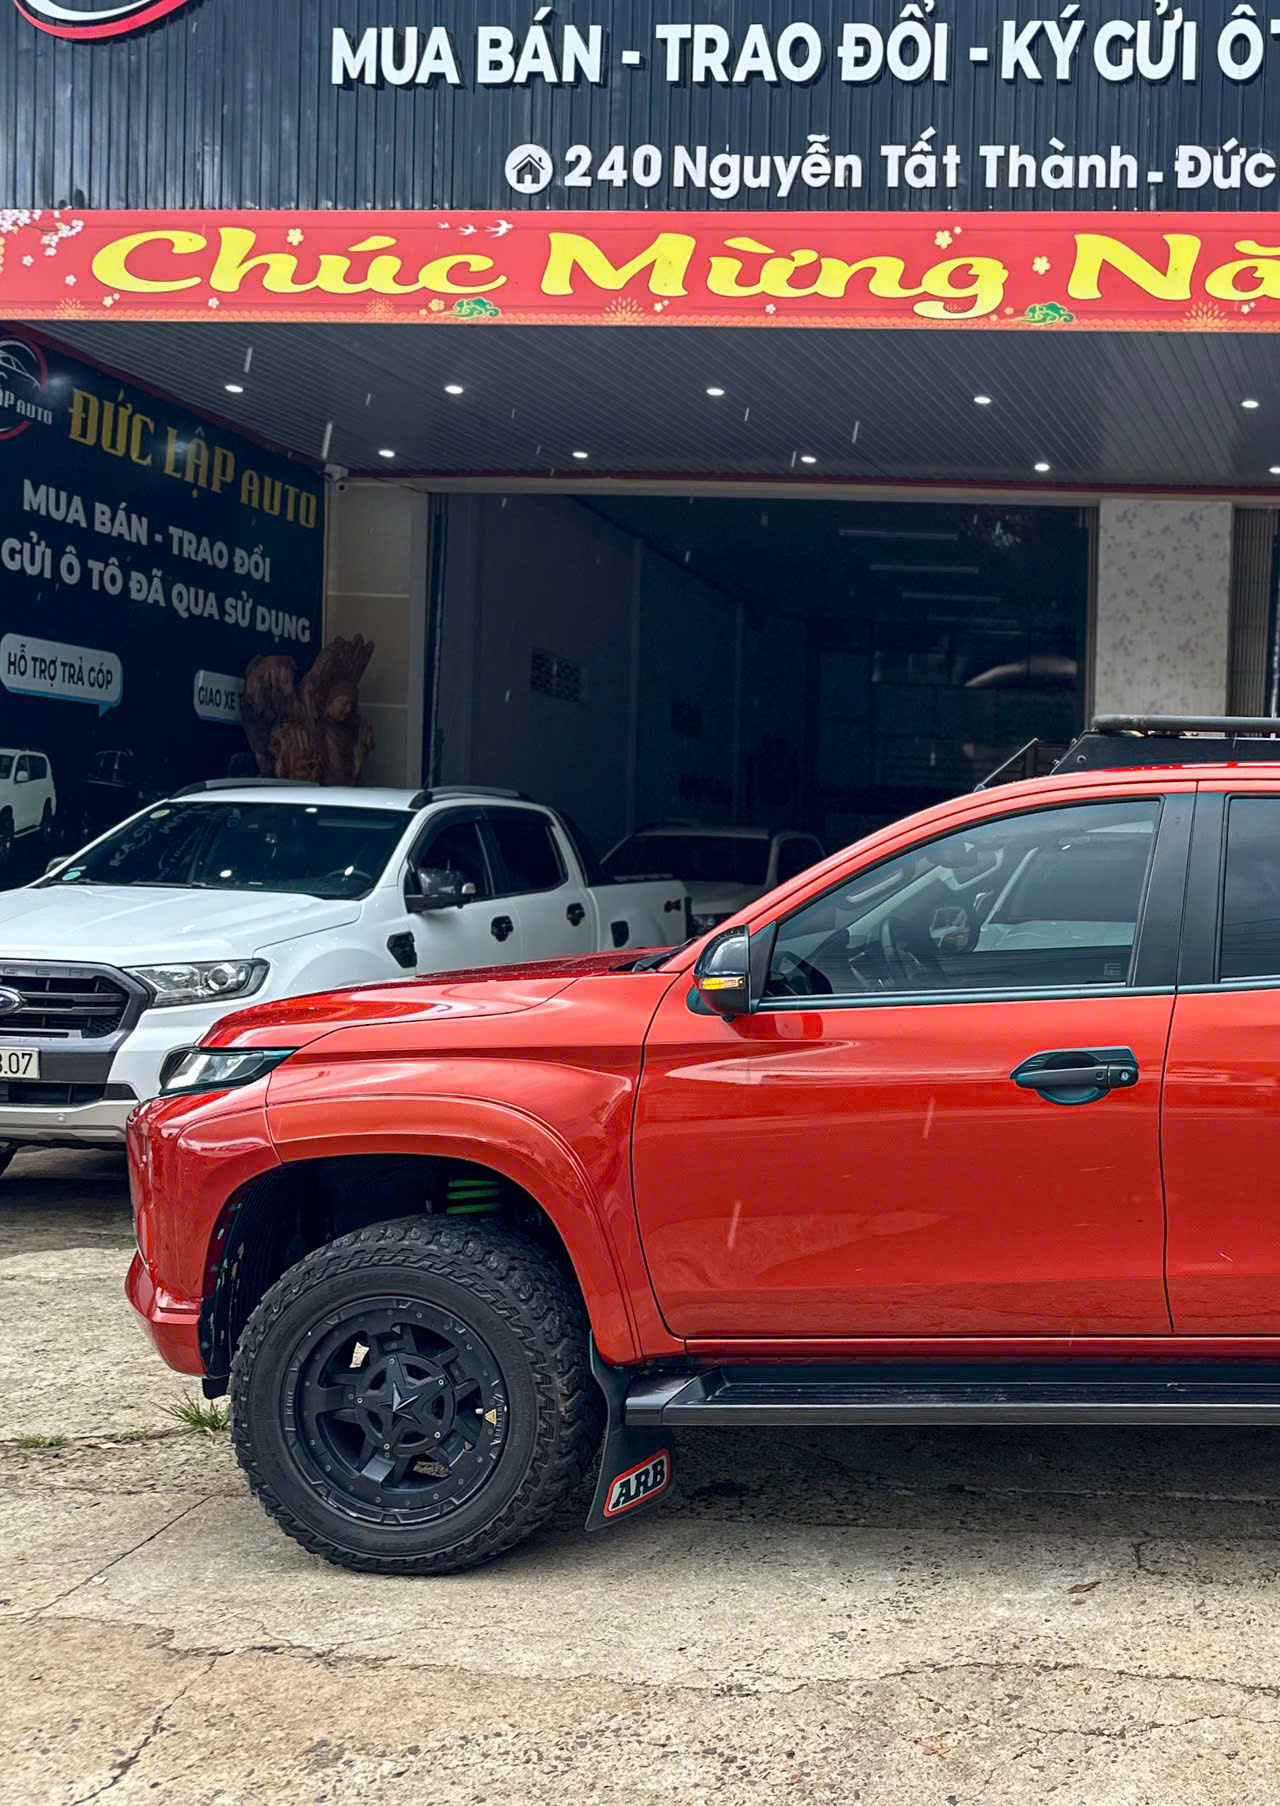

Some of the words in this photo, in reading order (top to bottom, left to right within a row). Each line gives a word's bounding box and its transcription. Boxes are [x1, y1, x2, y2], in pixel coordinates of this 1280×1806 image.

[331, 26, 460, 85] MUA
[476, 6, 602, 84] BÁN
[655, 22, 823, 82] TRAO
[836, 0, 948, 82] ĐỔI
[1001, 4, 1085, 81] KÝ
[1093, 0, 1197, 81] GỬI
[564, 144, 662, 187] 240
[673, 134, 863, 200] Nguyễn
[880, 126, 961, 188] Tất
[979, 136, 1138, 189] Thành
[1174, 137, 1276, 189] Đức
[91, 228, 507, 294] Chúc
[541, 232, 1005, 320] Mừng
[16, 399, 53, 425] AUTO
[68, 388, 155, 467] ĐỨC
[164, 426, 236, 499] LẬP
[240, 468, 317, 529] AUTO
[23, 479, 88, 528] MUA
[94, 502, 149, 546] BÁN
[168, 525, 229, 569] TRAO
[233, 544, 271, 583] ĐỔI
[1, 531, 52, 579] GỬI
[59, 545, 81, 585] Ô
[88, 557, 123, 596] TÔ
[129, 568, 166, 607] ĐÃ
[171, 583, 220, 619] QUA
[224, 590, 254, 628] SỬ
[256, 605, 311, 643] DỤNG
[8, 643, 28, 677] HỖ
[31, 656, 58, 688] TRỢ
[61, 656, 85, 687] TRẢ
[88, 662, 113, 690] GÓP
[198, 686, 222, 708] GIAO
[224, 689, 236, 710] XE
[0, 1052, 33, 1076] .07
[610, 1458, 666, 1511] ARB
